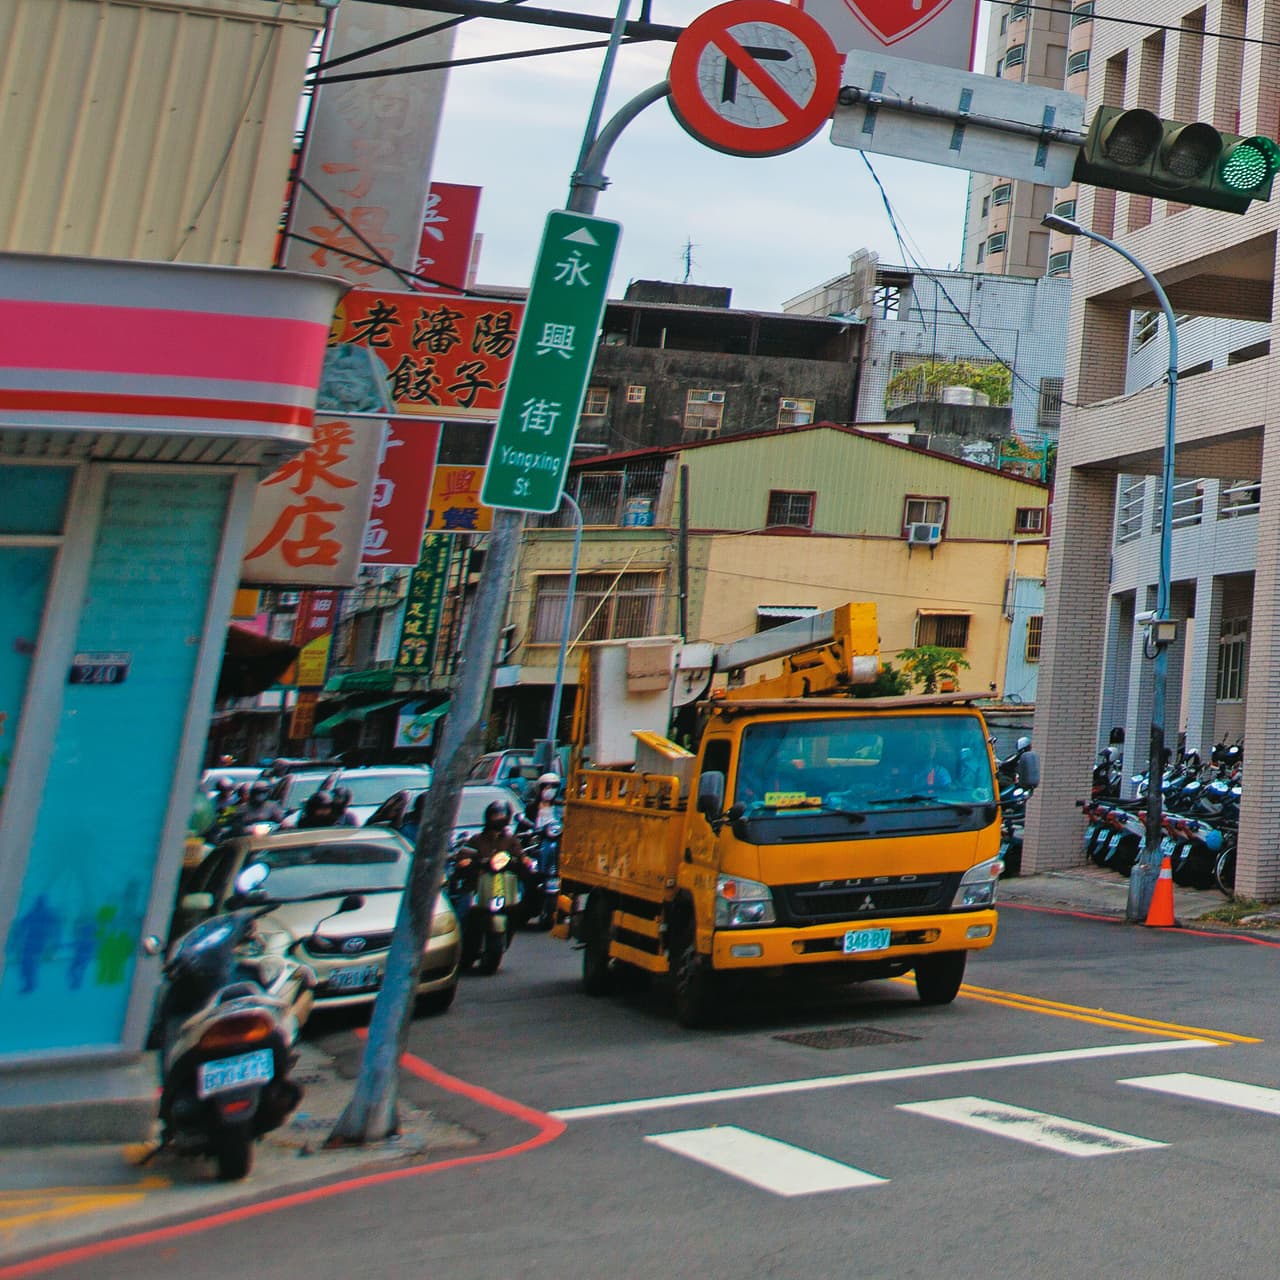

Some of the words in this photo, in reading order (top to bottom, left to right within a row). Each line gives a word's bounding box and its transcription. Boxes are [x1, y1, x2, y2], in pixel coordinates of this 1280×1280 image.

[519, 249, 592, 436] 永興街
[386, 355, 507, 409] 餃子
[501, 444, 561, 477] Yongxing
[818, 874, 918, 889] FUSO
